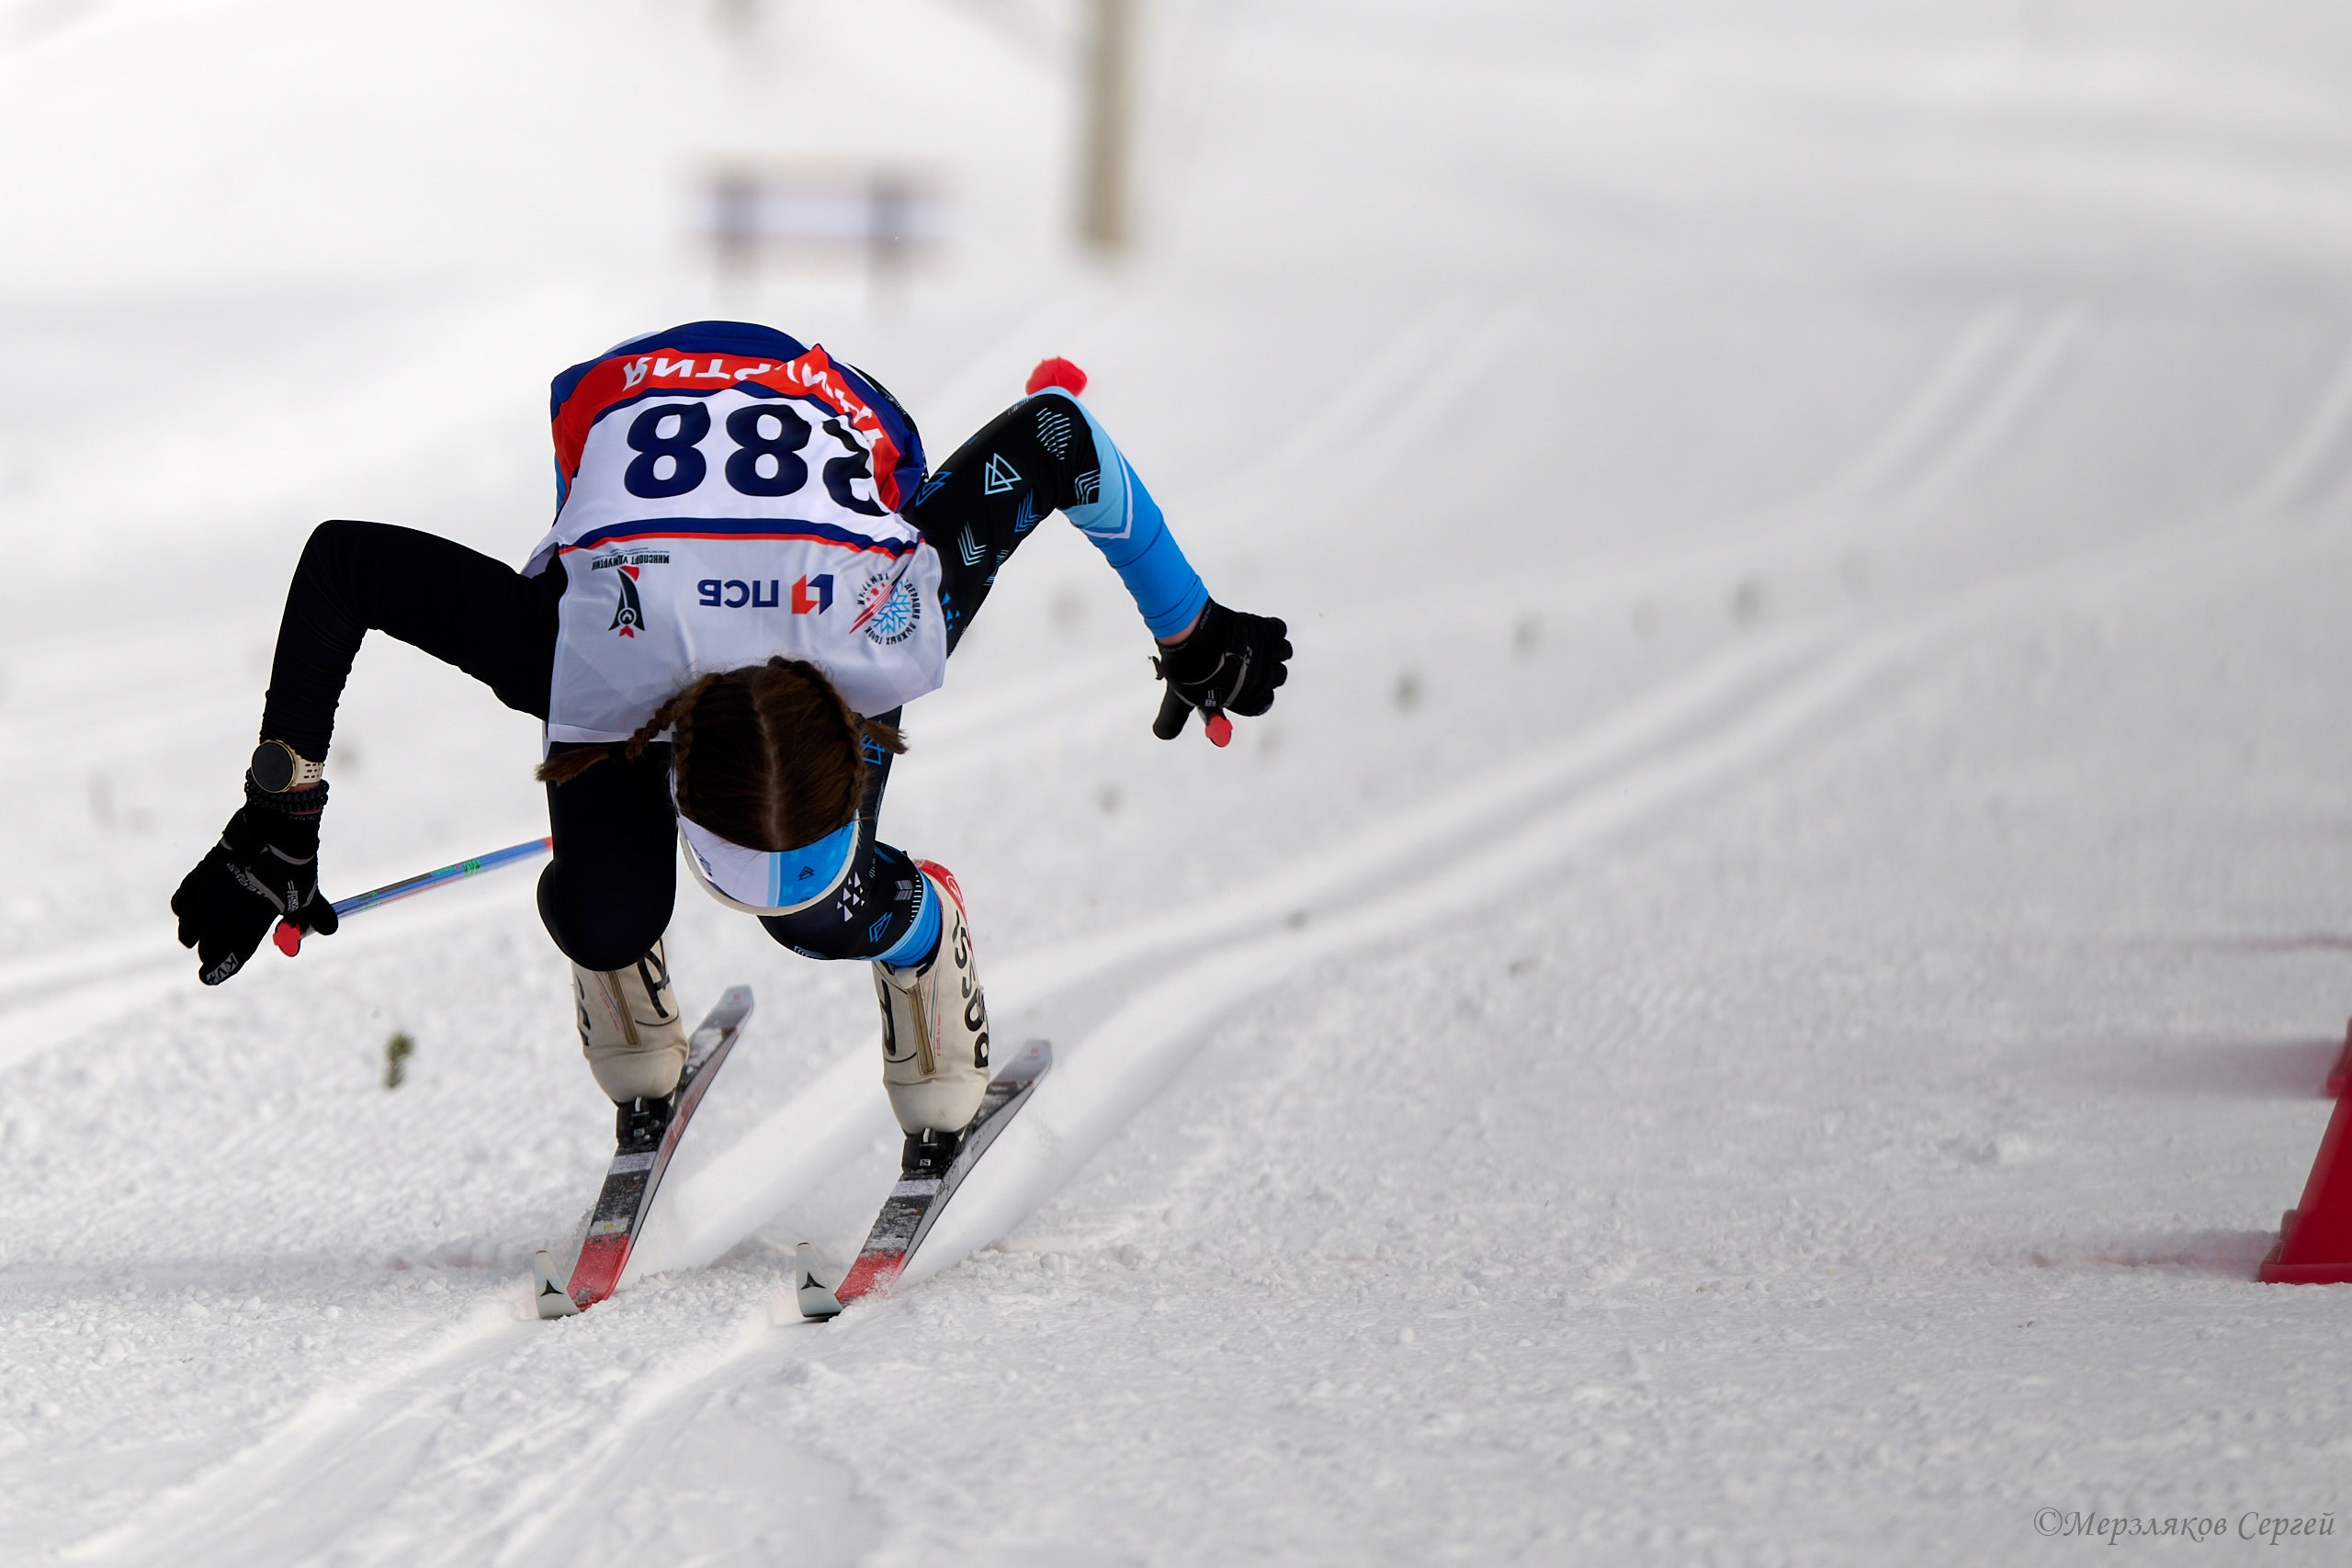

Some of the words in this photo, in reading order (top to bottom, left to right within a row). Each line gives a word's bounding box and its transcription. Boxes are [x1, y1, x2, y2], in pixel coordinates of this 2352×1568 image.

[630, 554, 670, 565] МИНСПОРТ
[697, 577, 779, 607] ПСБ
[904, 579, 921, 620] ДЕРАЦИЯ
[886, 622, 917, 645] ЛЫЖНЫХ
